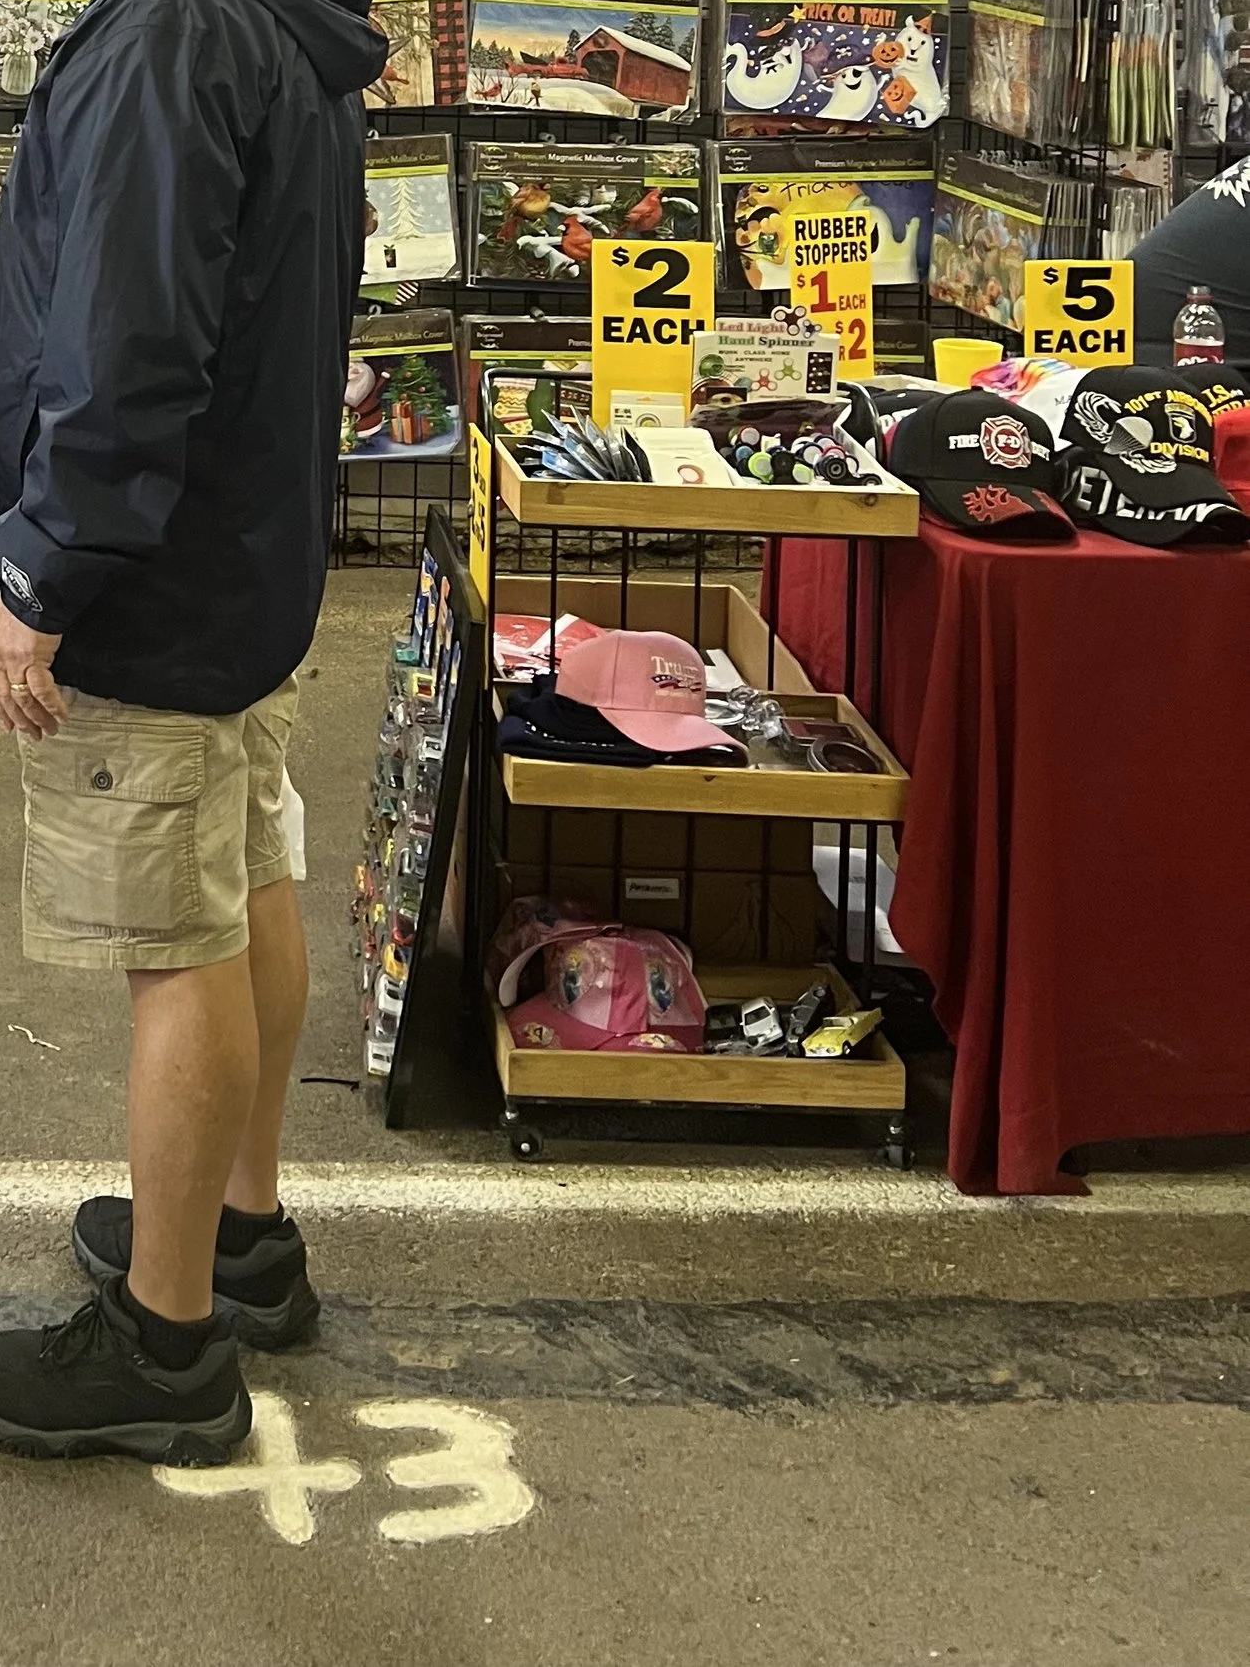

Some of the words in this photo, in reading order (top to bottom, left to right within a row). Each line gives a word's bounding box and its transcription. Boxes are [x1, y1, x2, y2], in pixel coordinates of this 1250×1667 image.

[802, 3, 834, 20] TRICK
[838, 6, 855, 22] OR
[860, 6, 896, 27] TREAT!
[549, 152, 583, 163] Magnetic
[585, 153, 614, 163] Mailbox
[616, 155, 639, 164] Cover
[795, 216, 866, 241] RUBBER
[795, 241, 867, 266] STOPPERS
[612, 245, 691, 309] $2
[797, 271, 836, 313] $1
[839, 294, 866, 310] EACH
[1043, 266, 1115, 322] $5
[603, 316, 704, 345] EACH
[719, 322, 744, 332] Led
[747, 321, 786, 333] Light
[718, 335, 755, 346] Hand
[758, 336, 815, 348] Spinner
[1034, 330, 1126, 353] EACH
[949, 435, 979, 449] FIRE
[1150, 442, 1209, 462] DIVISION
[651, 656, 699, 679] Tru
